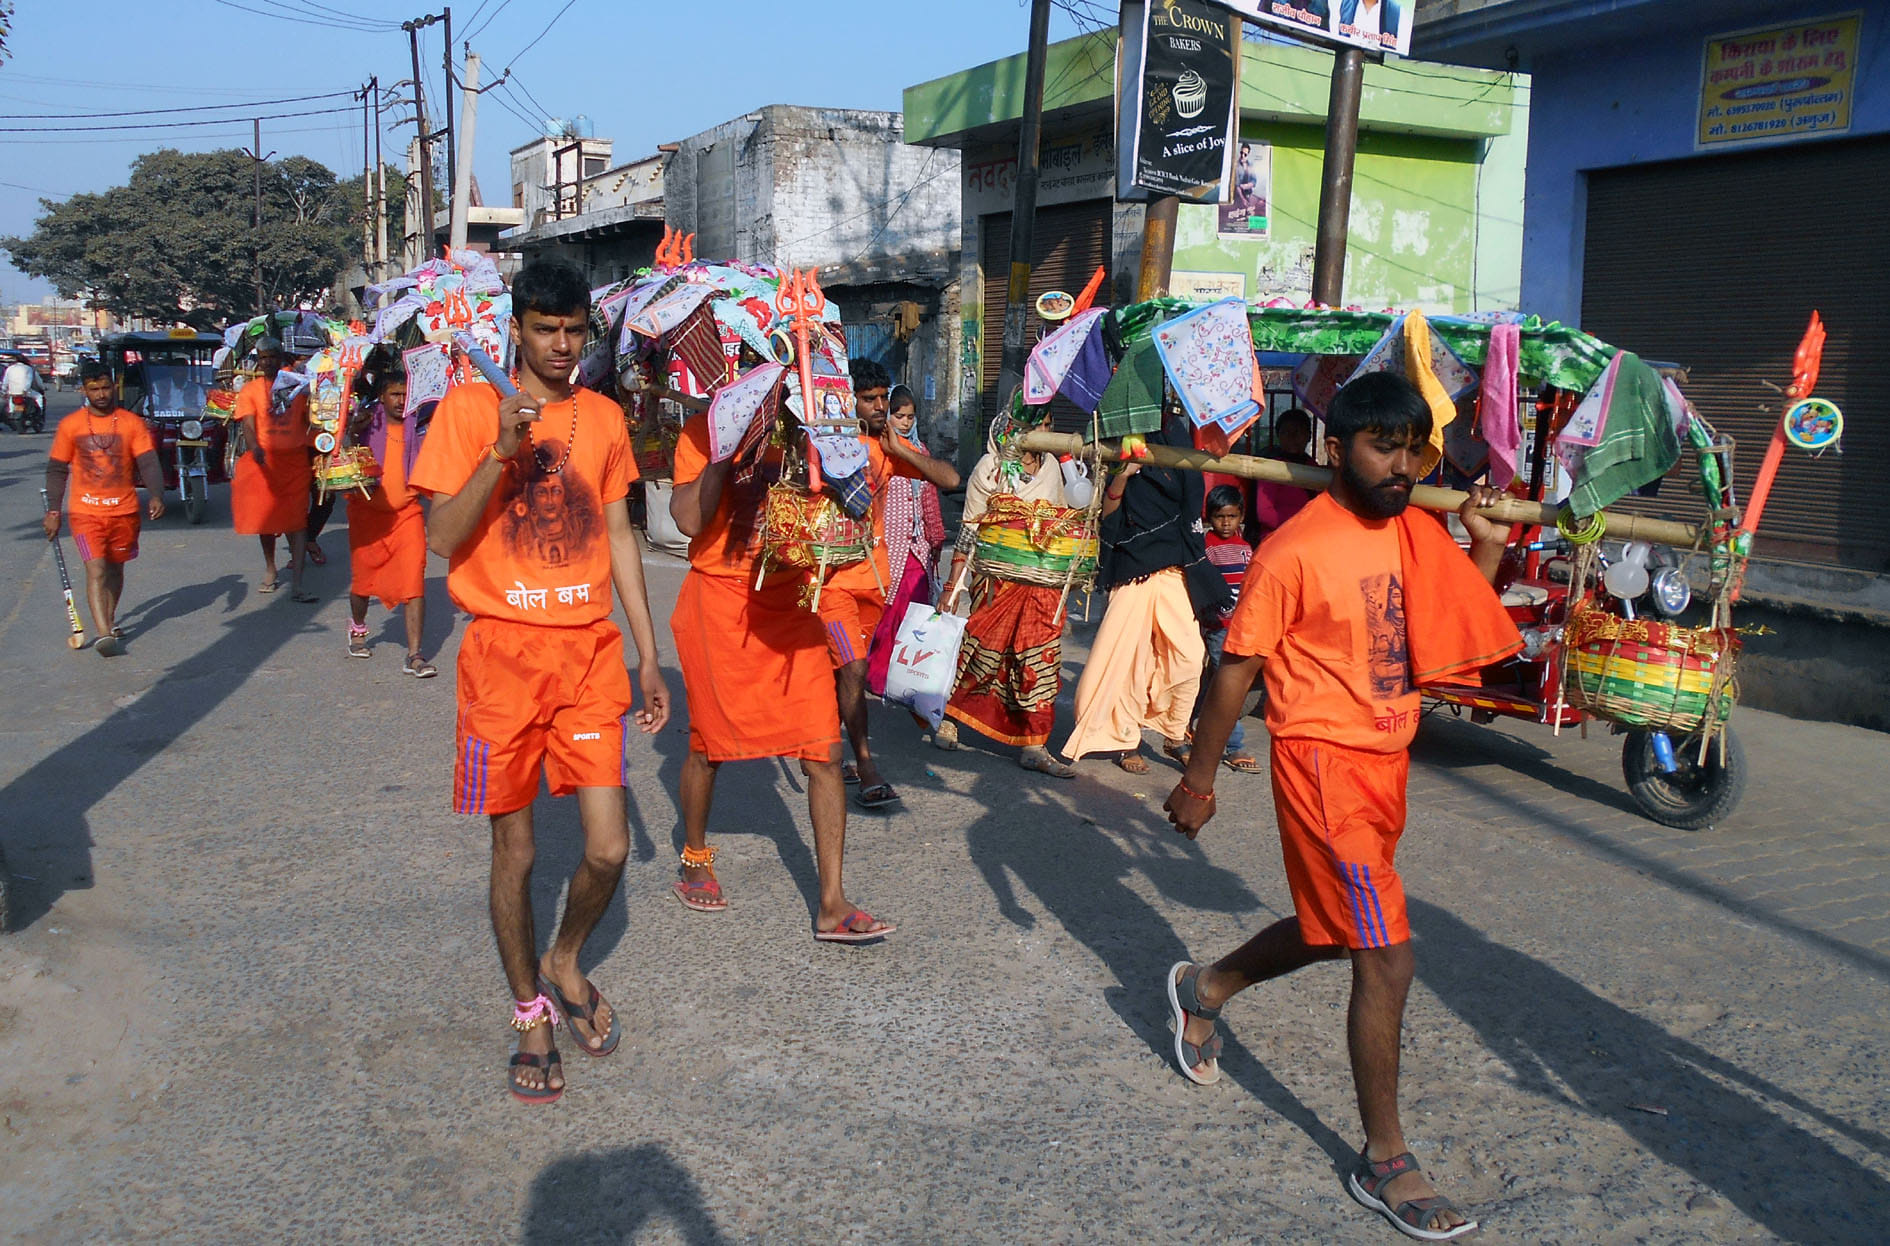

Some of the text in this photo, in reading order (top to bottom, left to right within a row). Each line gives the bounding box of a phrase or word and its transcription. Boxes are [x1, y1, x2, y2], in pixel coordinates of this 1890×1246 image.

[1153, 5, 1224, 40] THE CROWN
[1169, 37, 1202, 51] BAKERS
[1162, 146, 1171, 157] A
[1173, 143, 1194, 155] slice
[1196, 137, 1207, 151] of
[505, 581, 590, 610] बोल बम
[1374, 706, 1408, 734] बोल
[572, 732, 600, 741] SPORTS
